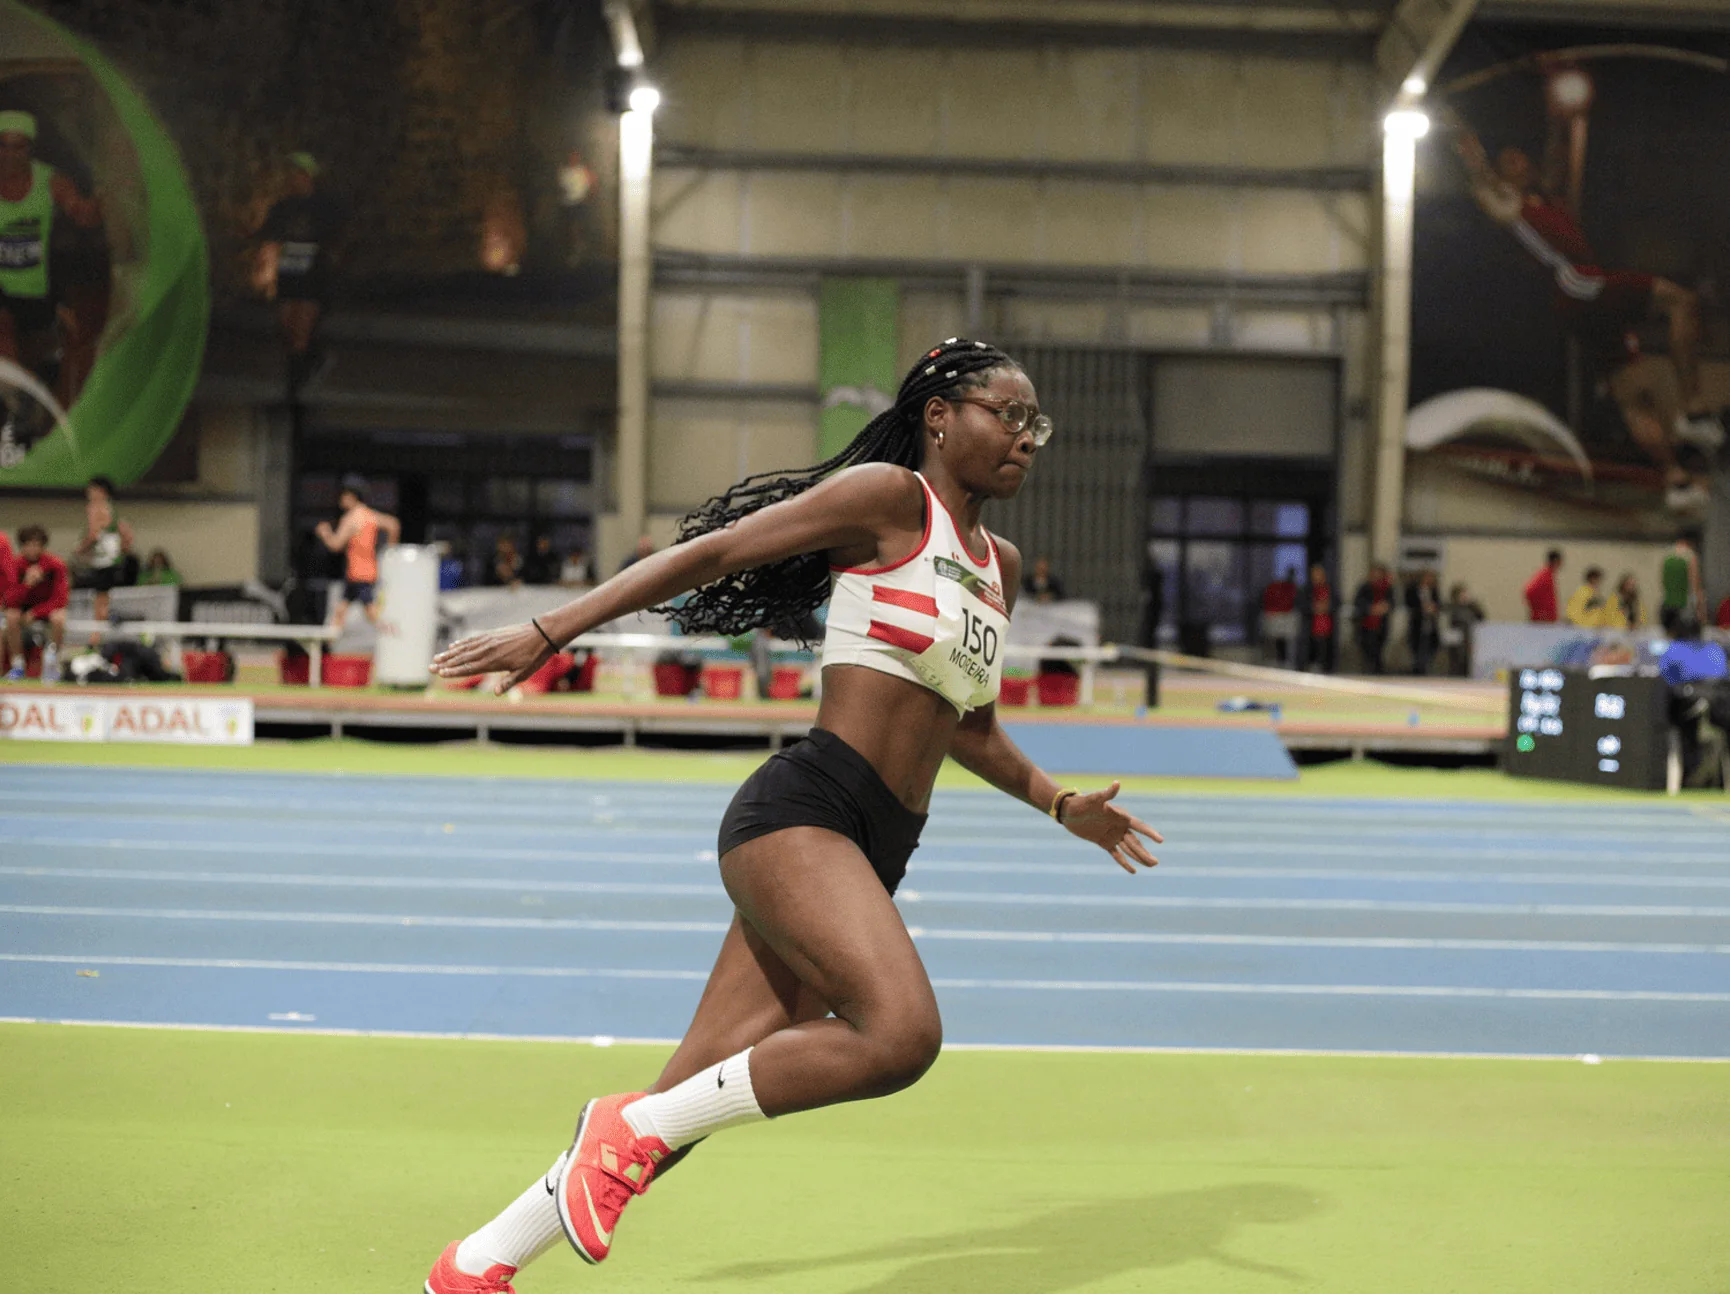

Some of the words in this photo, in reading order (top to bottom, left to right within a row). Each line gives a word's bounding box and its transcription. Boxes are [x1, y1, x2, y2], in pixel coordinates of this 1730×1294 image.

[962, 607, 997, 666] 150
[949, 647, 990, 688] MOREIRA
[113, 704, 211, 735] ADAL
